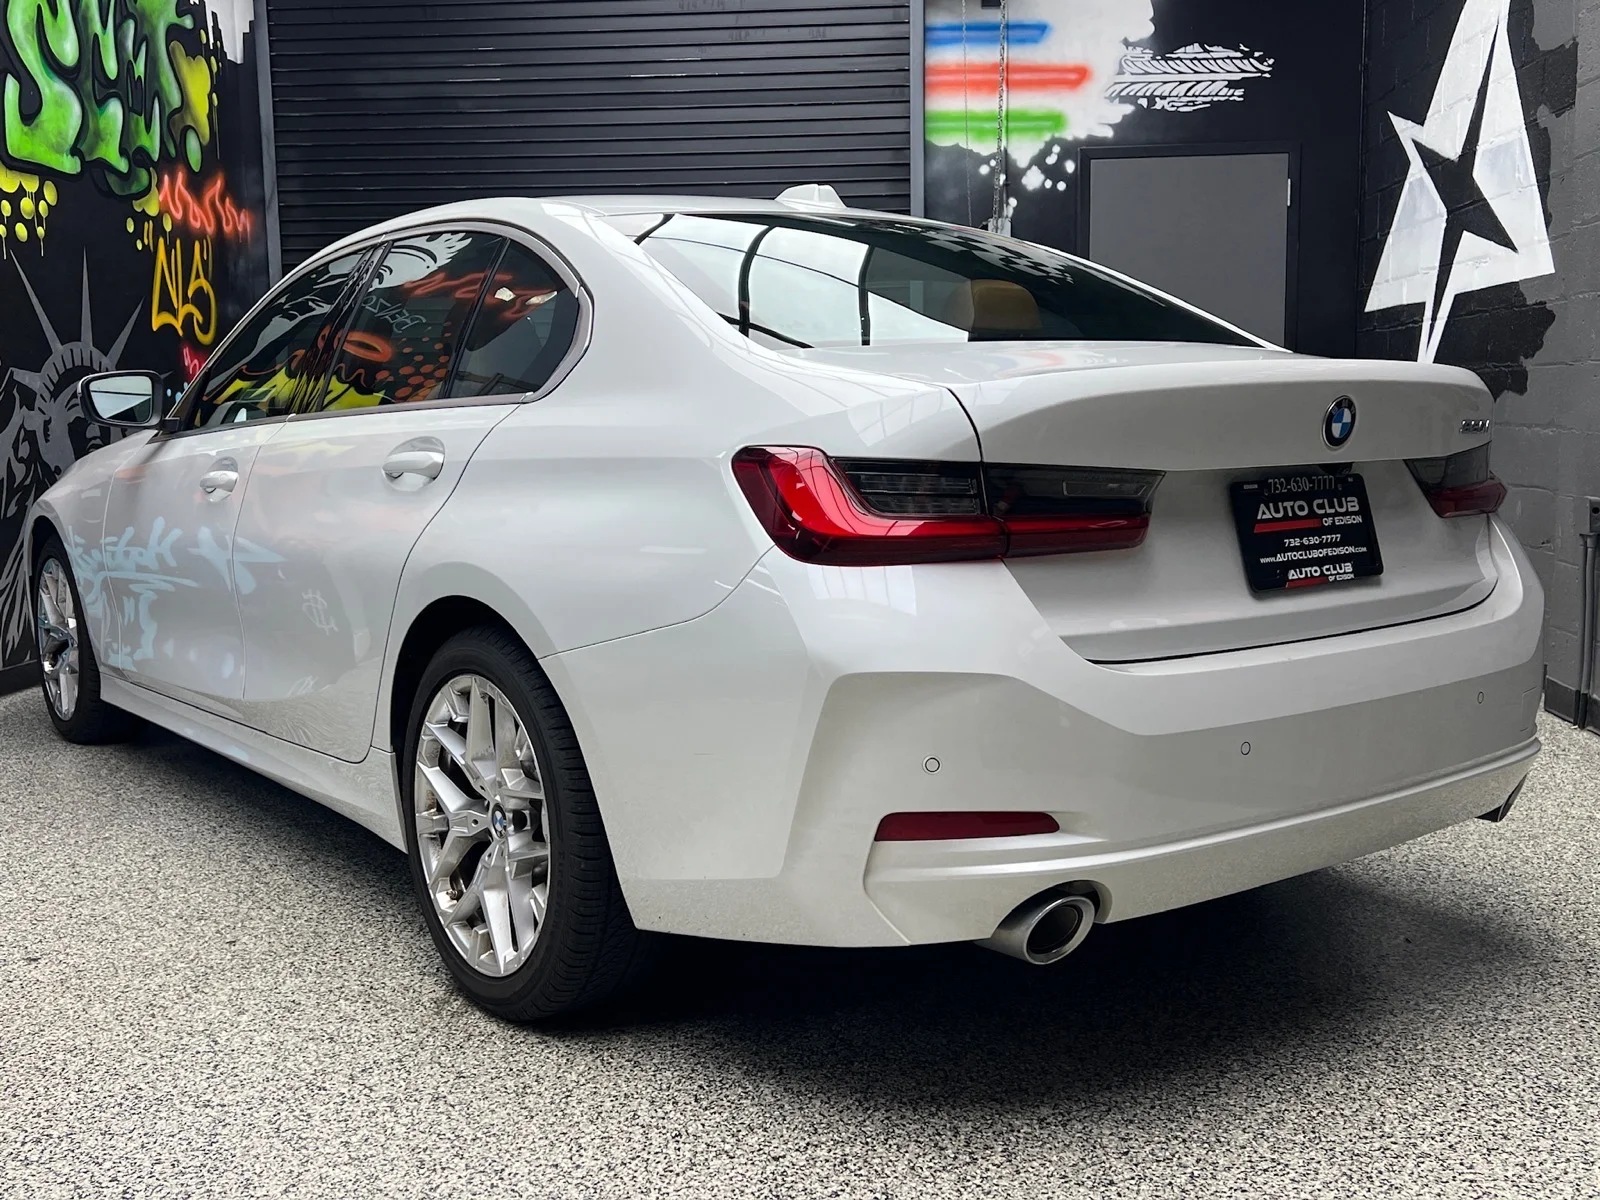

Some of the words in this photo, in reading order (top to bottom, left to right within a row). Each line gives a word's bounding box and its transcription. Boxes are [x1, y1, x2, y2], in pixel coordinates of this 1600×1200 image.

[1268, 475, 1335, 494] 732-630-7777
[1257, 500, 1308, 520] AUTO
[1313, 496, 1360, 515] CLUB
[1322, 517, 1333, 526] OF
[1335, 515, 1362, 526] EDISON
[1284, 534, 1341, 547] 732-630-7777
[1288, 567, 1320, 580] AUTO
[1322, 563, 1353, 575] CLUB
